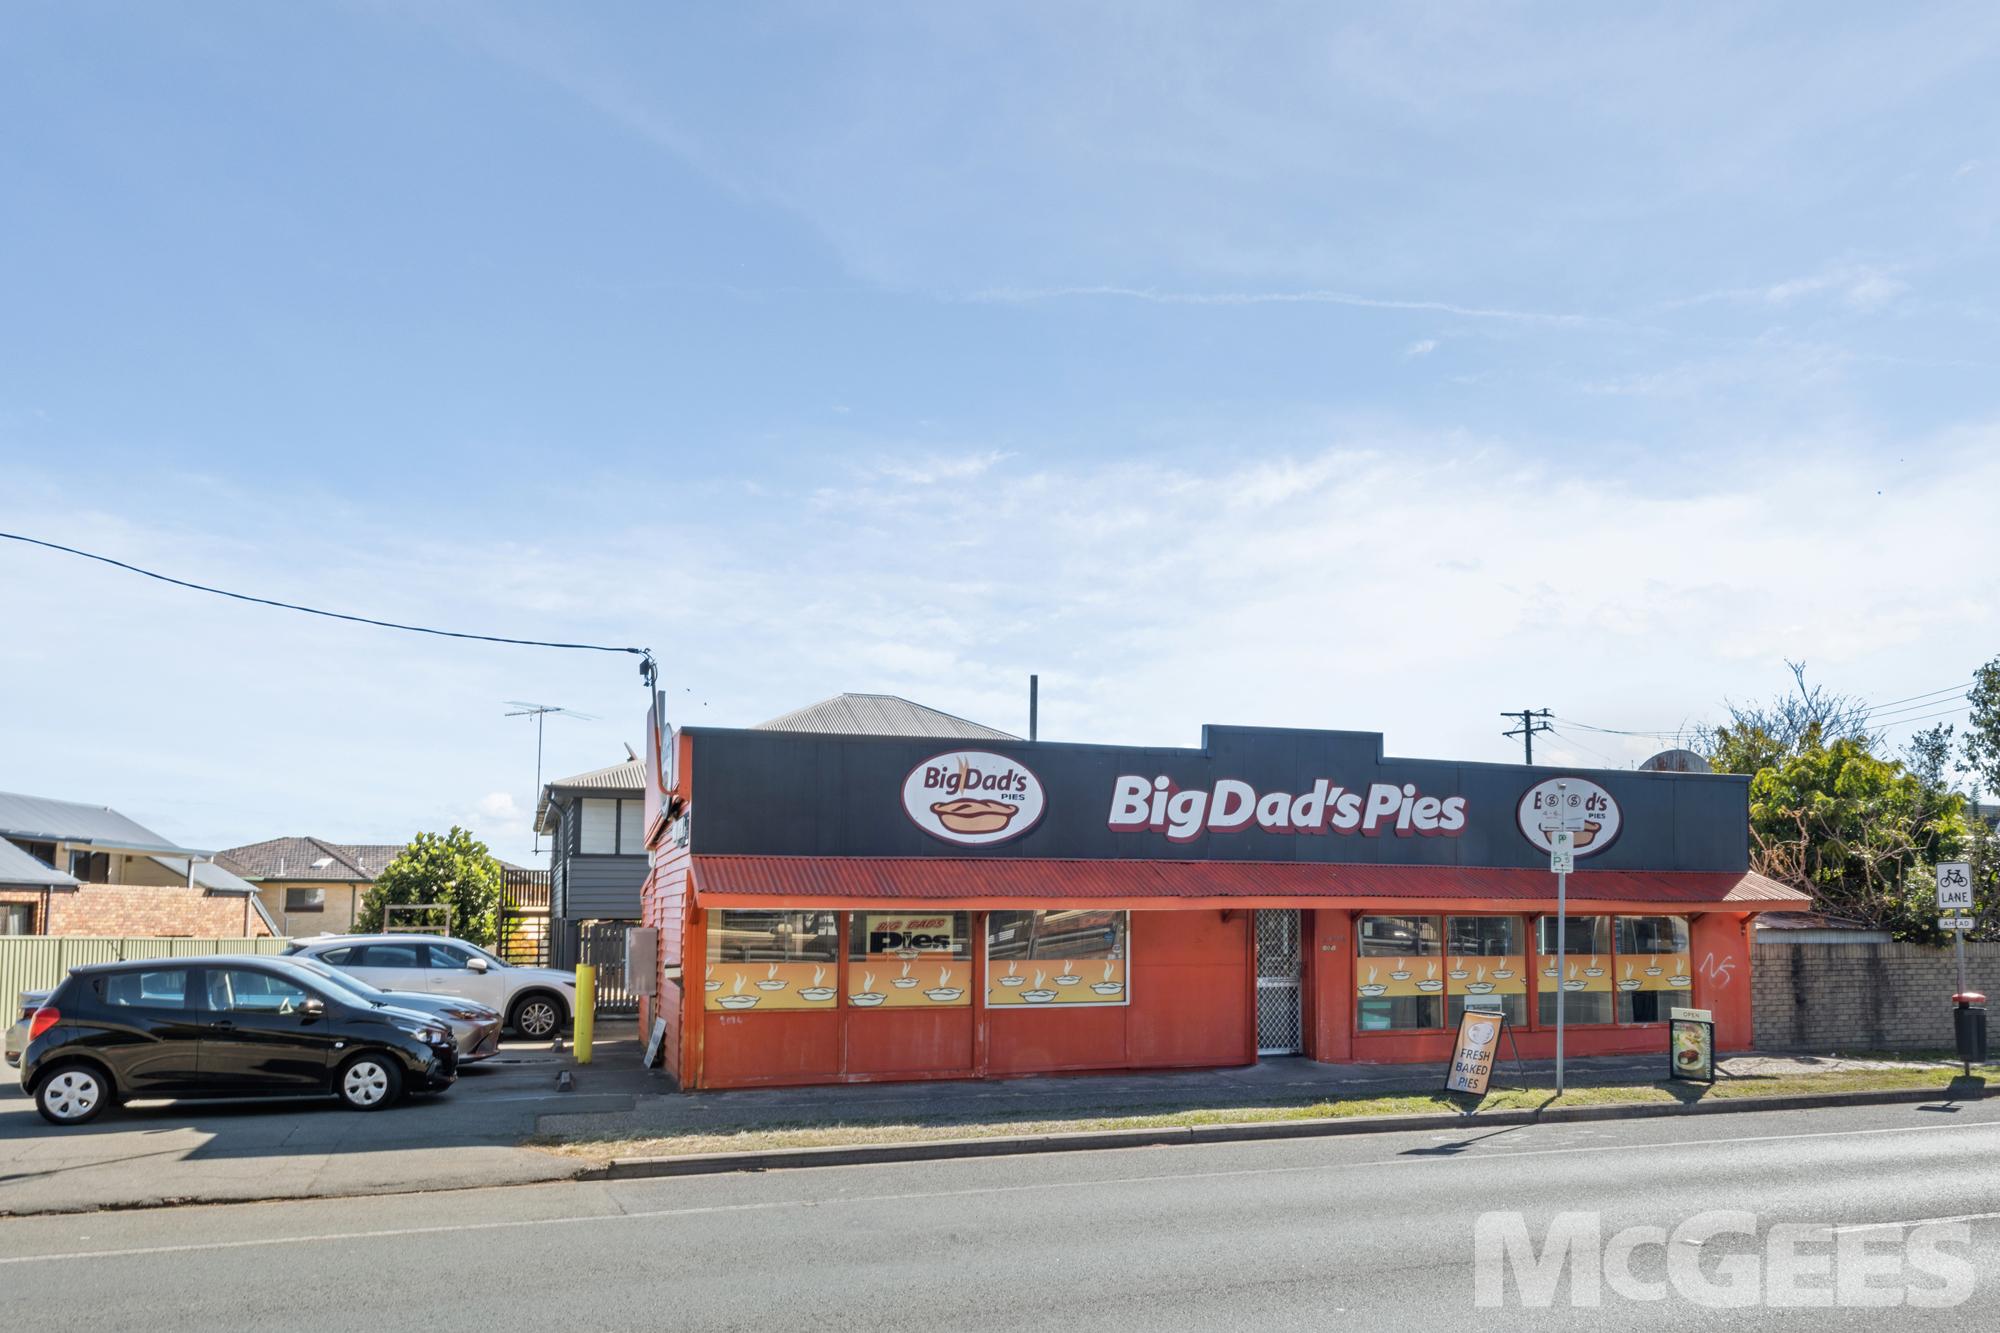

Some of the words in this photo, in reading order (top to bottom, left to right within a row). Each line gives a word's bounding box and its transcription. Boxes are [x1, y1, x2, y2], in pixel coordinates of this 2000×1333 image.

[1001, 793, 1025, 801] PIES
[1941, 891, 1968, 903] LANE
[1460, 1048, 1491, 1061] FRESH
[1455, 1062, 1488, 1075] BAKED
[1458, 1077, 1479, 1089] PIES
